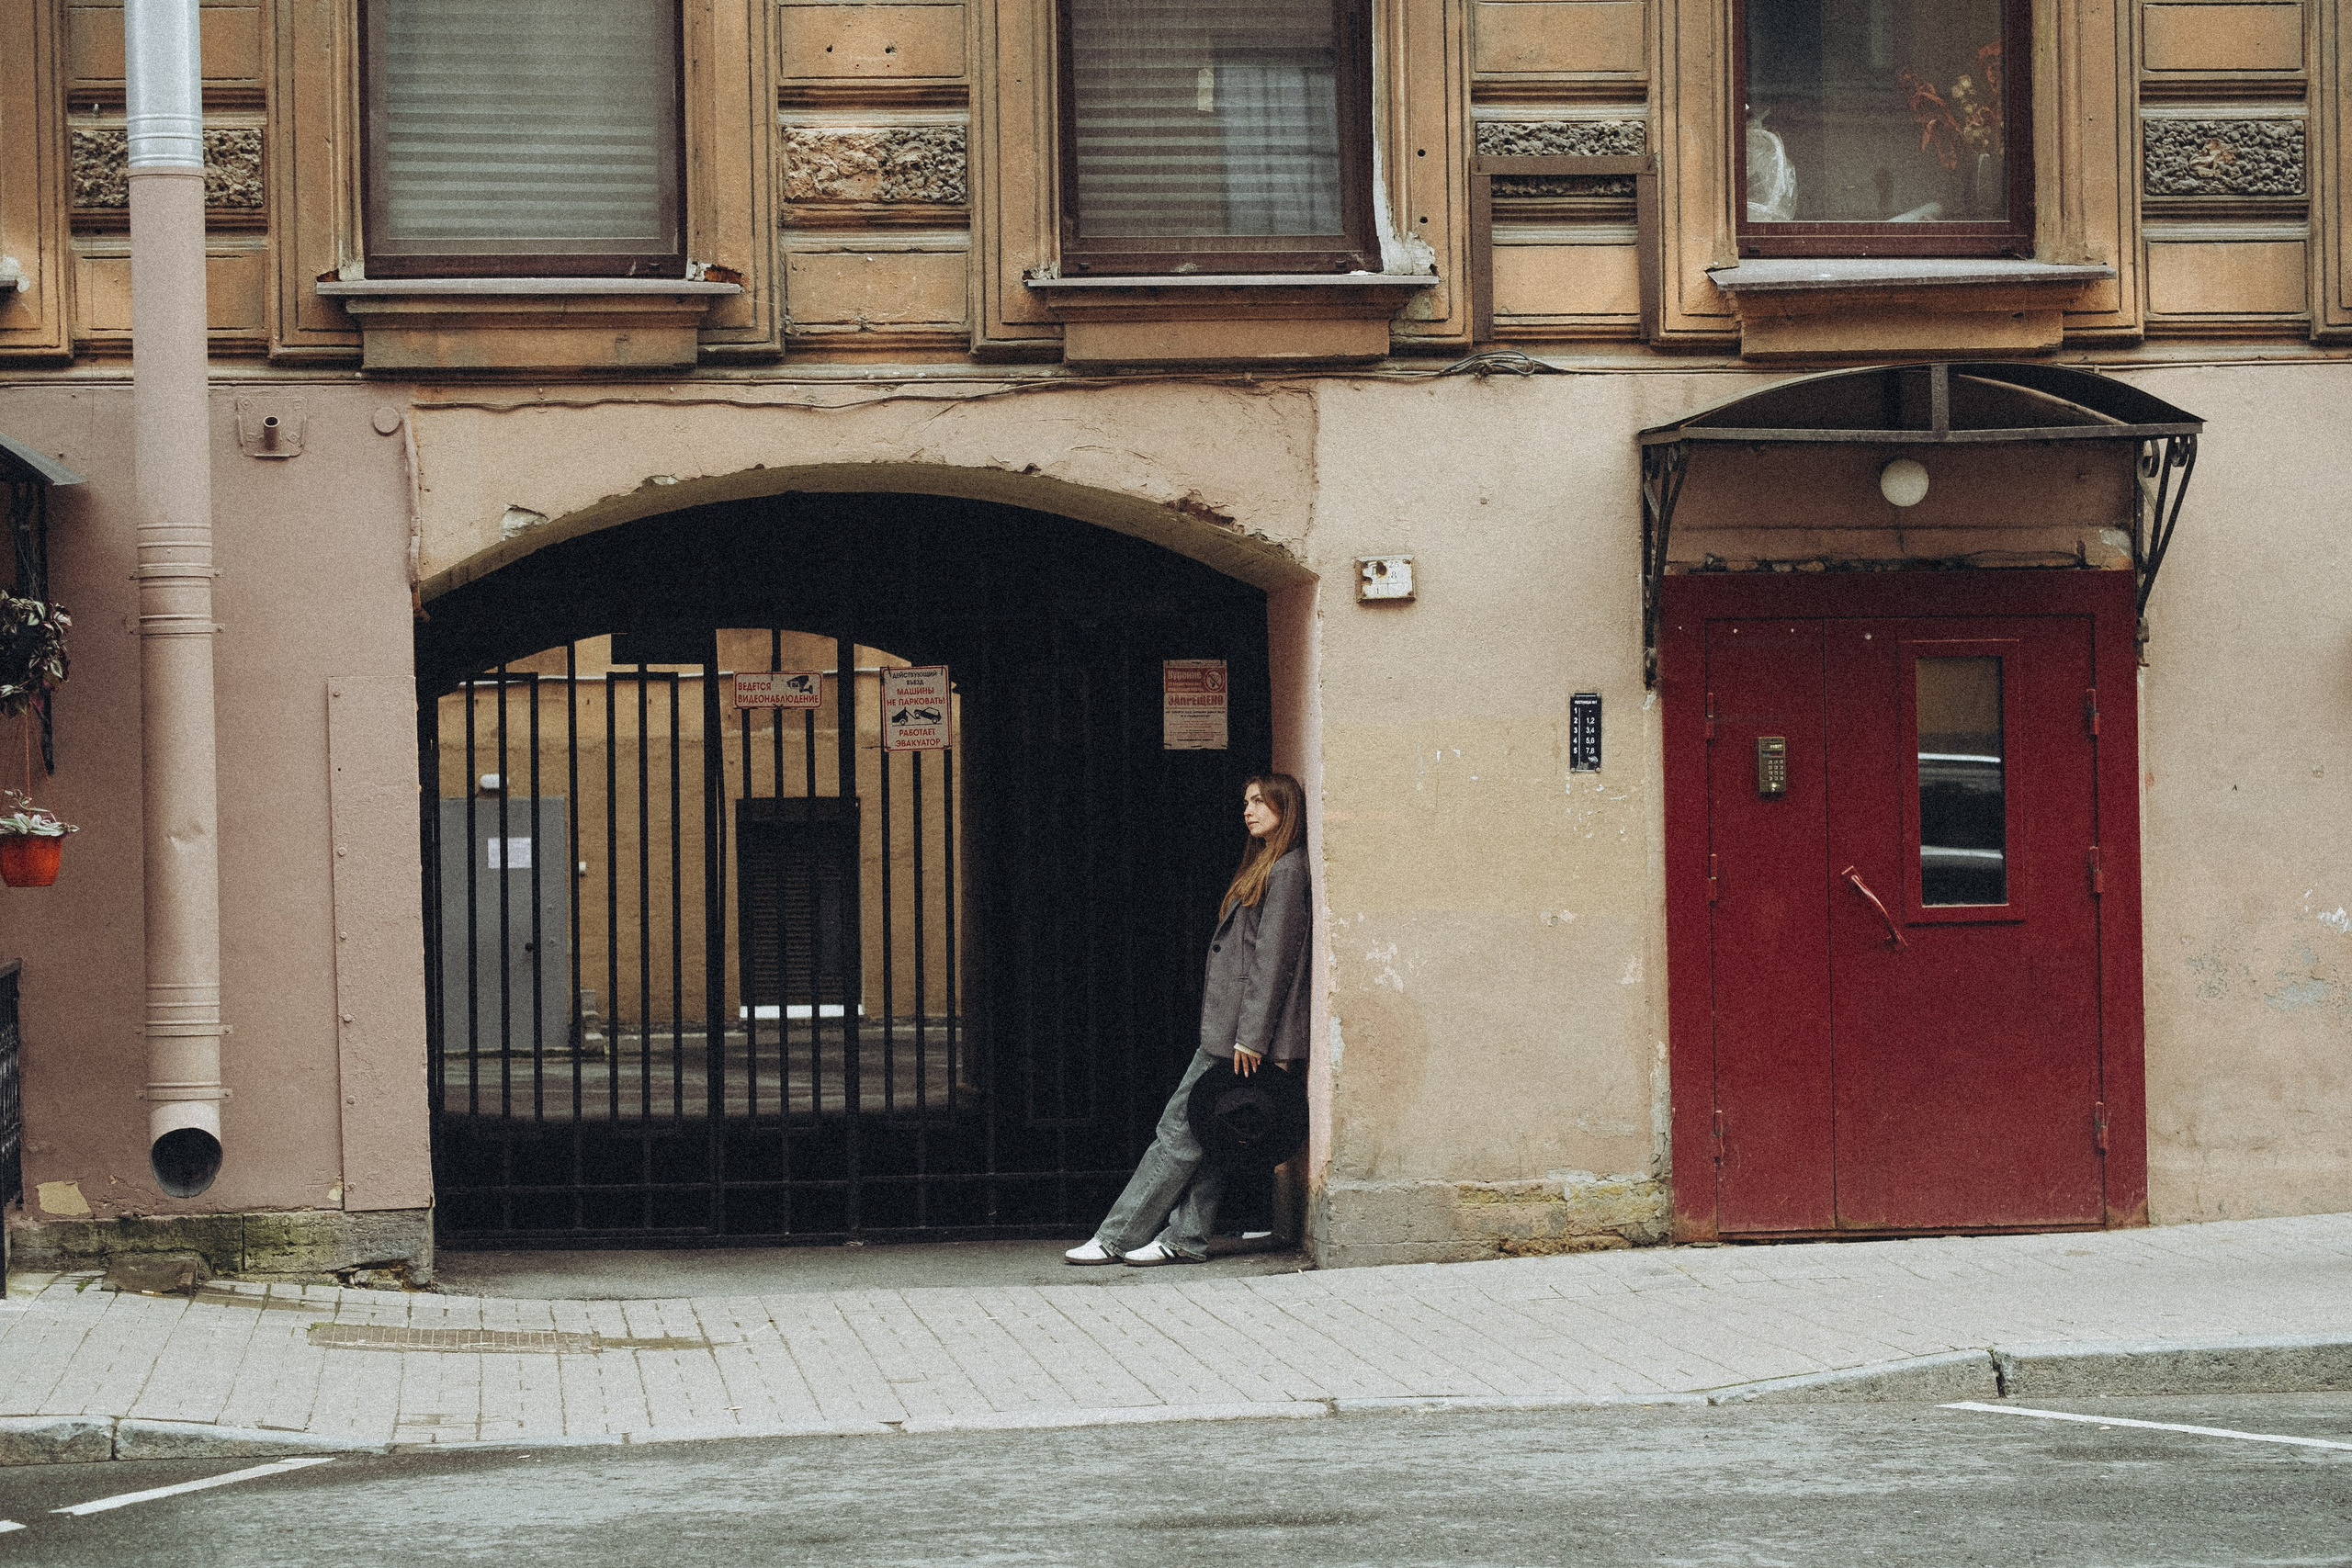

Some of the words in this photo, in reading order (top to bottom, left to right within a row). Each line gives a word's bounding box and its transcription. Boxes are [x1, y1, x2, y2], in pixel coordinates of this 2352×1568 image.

[892, 671, 937, 679] ДЕЙСТВУЮЩИЙ
[1168, 671, 1202, 681] Курение
[738, 682, 772, 691] ВЕДЕТСЯ
[897, 687, 934, 695] МАШИНЫ
[738, 694, 819, 704] ВИДЕОНАБЛЮДЕНИЕ
[899, 697, 946, 705] ПАРКОВАТЬ!
[1168, 695, 1224, 706] ЗАПРЕЩЕНО
[899, 728, 935, 737] РАБОТАЕТ
[895, 738, 941, 747] ЭВАКУАТОР
